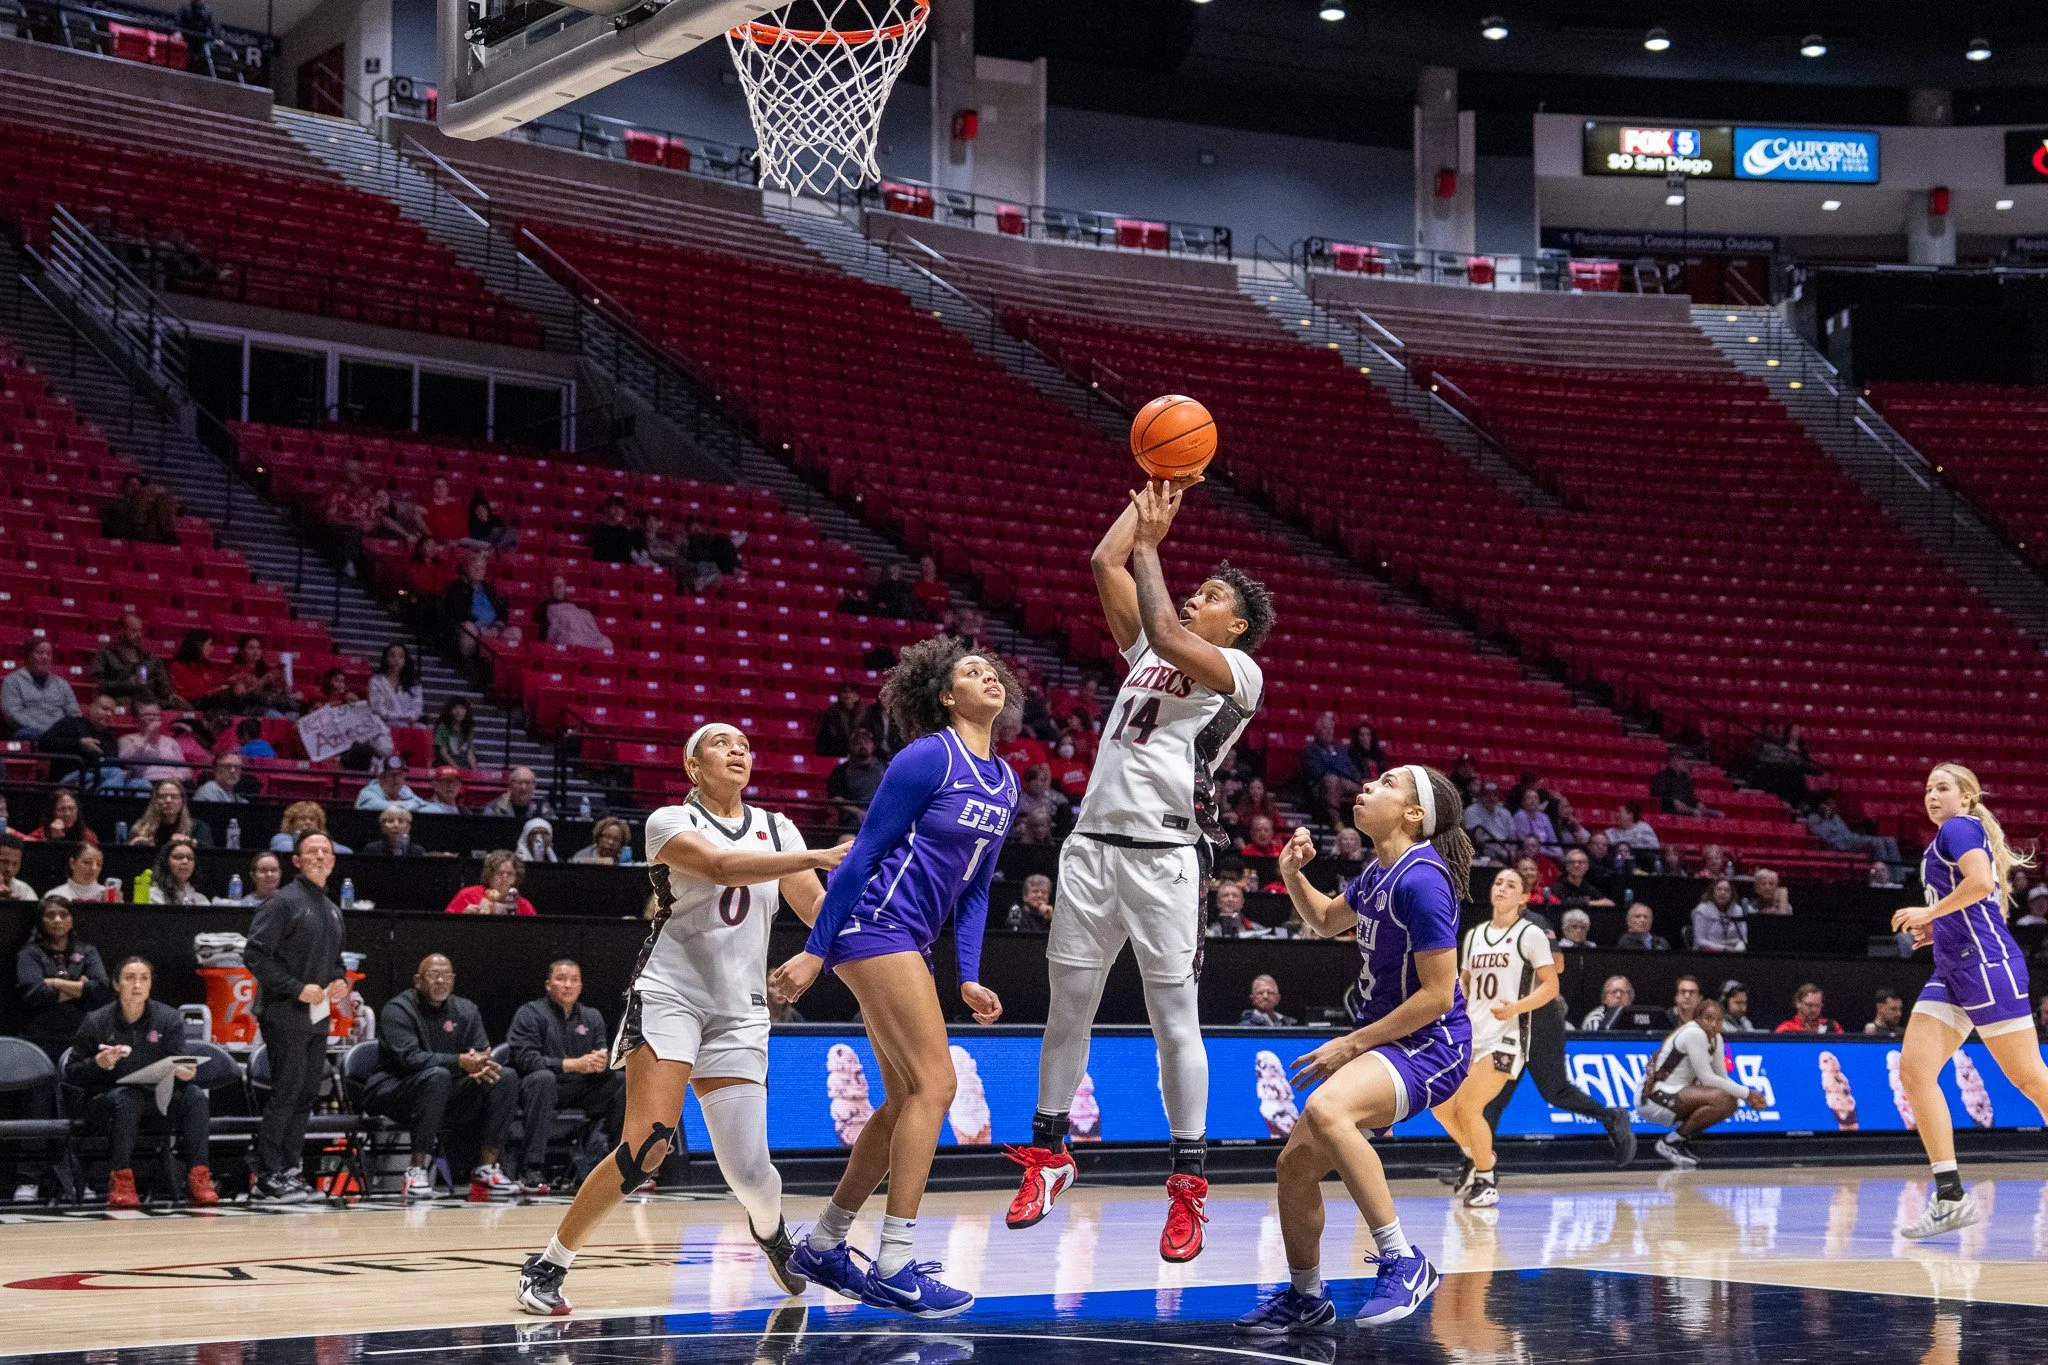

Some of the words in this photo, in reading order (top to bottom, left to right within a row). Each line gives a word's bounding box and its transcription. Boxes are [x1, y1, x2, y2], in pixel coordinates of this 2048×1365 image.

[247, 48, 262, 67] R
[1624, 129, 1673, 154] FOX
[1677, 131, 1695, 156] 5
[1773, 138, 1868, 158] CALIFORNIA
[1634, 154, 1665, 171] San
[1666, 155, 1713, 175] Diego
[1784, 156, 1842, 172] COAST
[1667, 263, 1680, 280] P
[1110, 694, 1162, 746] 14
[962, 837, 990, 881] 1
[718, 885, 751, 927] 0
[1472, 952, 1510, 970] AZTECS
[233, 979, 253, 1001] G
[1476, 972, 1498, 1000] 10
[1733, 1109, 1760, 1123] 1945
